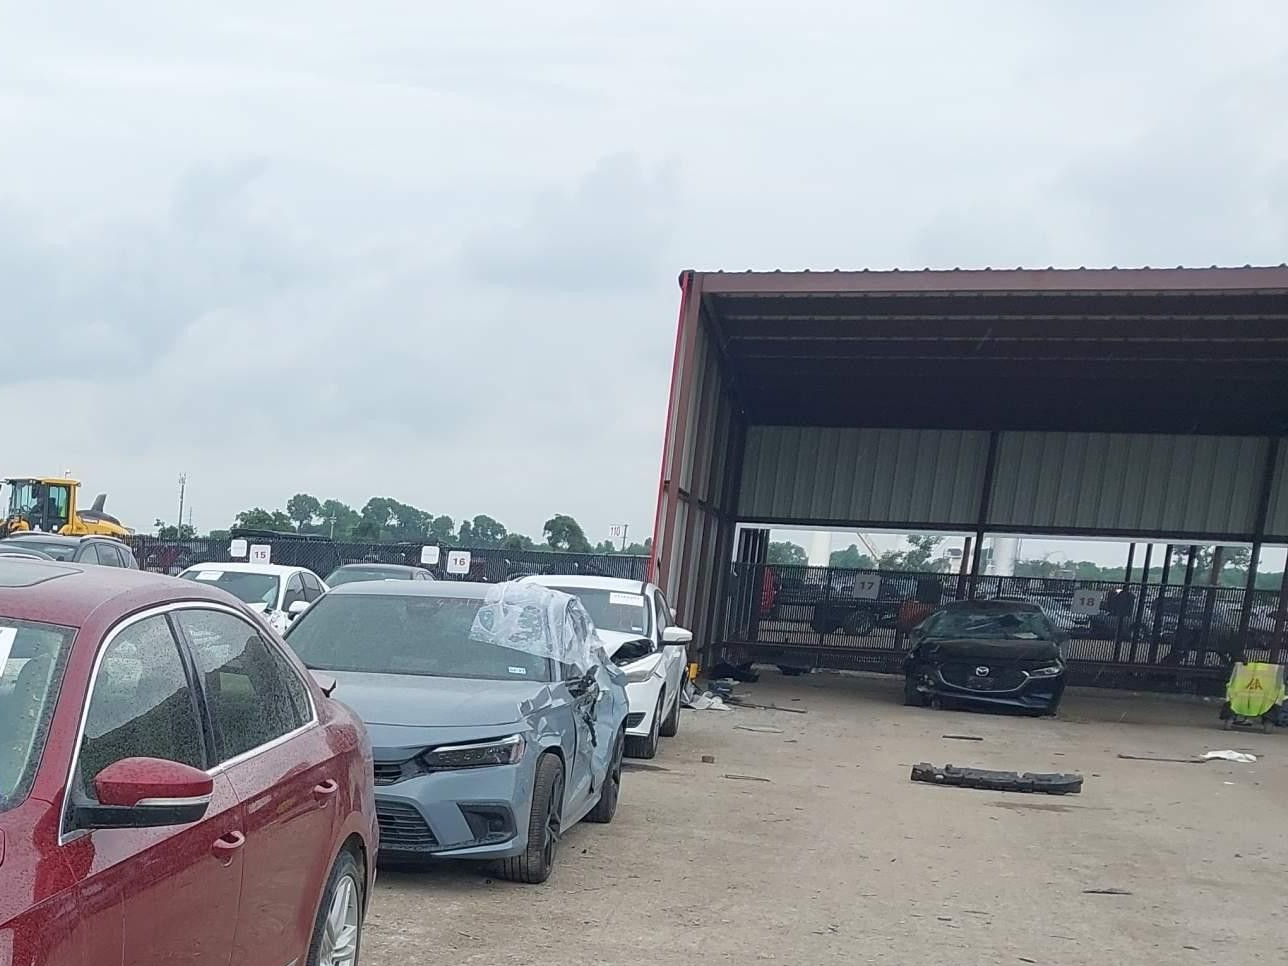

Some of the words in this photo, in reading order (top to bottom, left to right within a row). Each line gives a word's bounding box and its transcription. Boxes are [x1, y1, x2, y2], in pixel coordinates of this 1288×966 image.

[254, 551, 266, 559] 15
[453, 557, 466, 566] 16
[860, 581, 874, 590] 17
[1079, 597, 1095, 607] 18
